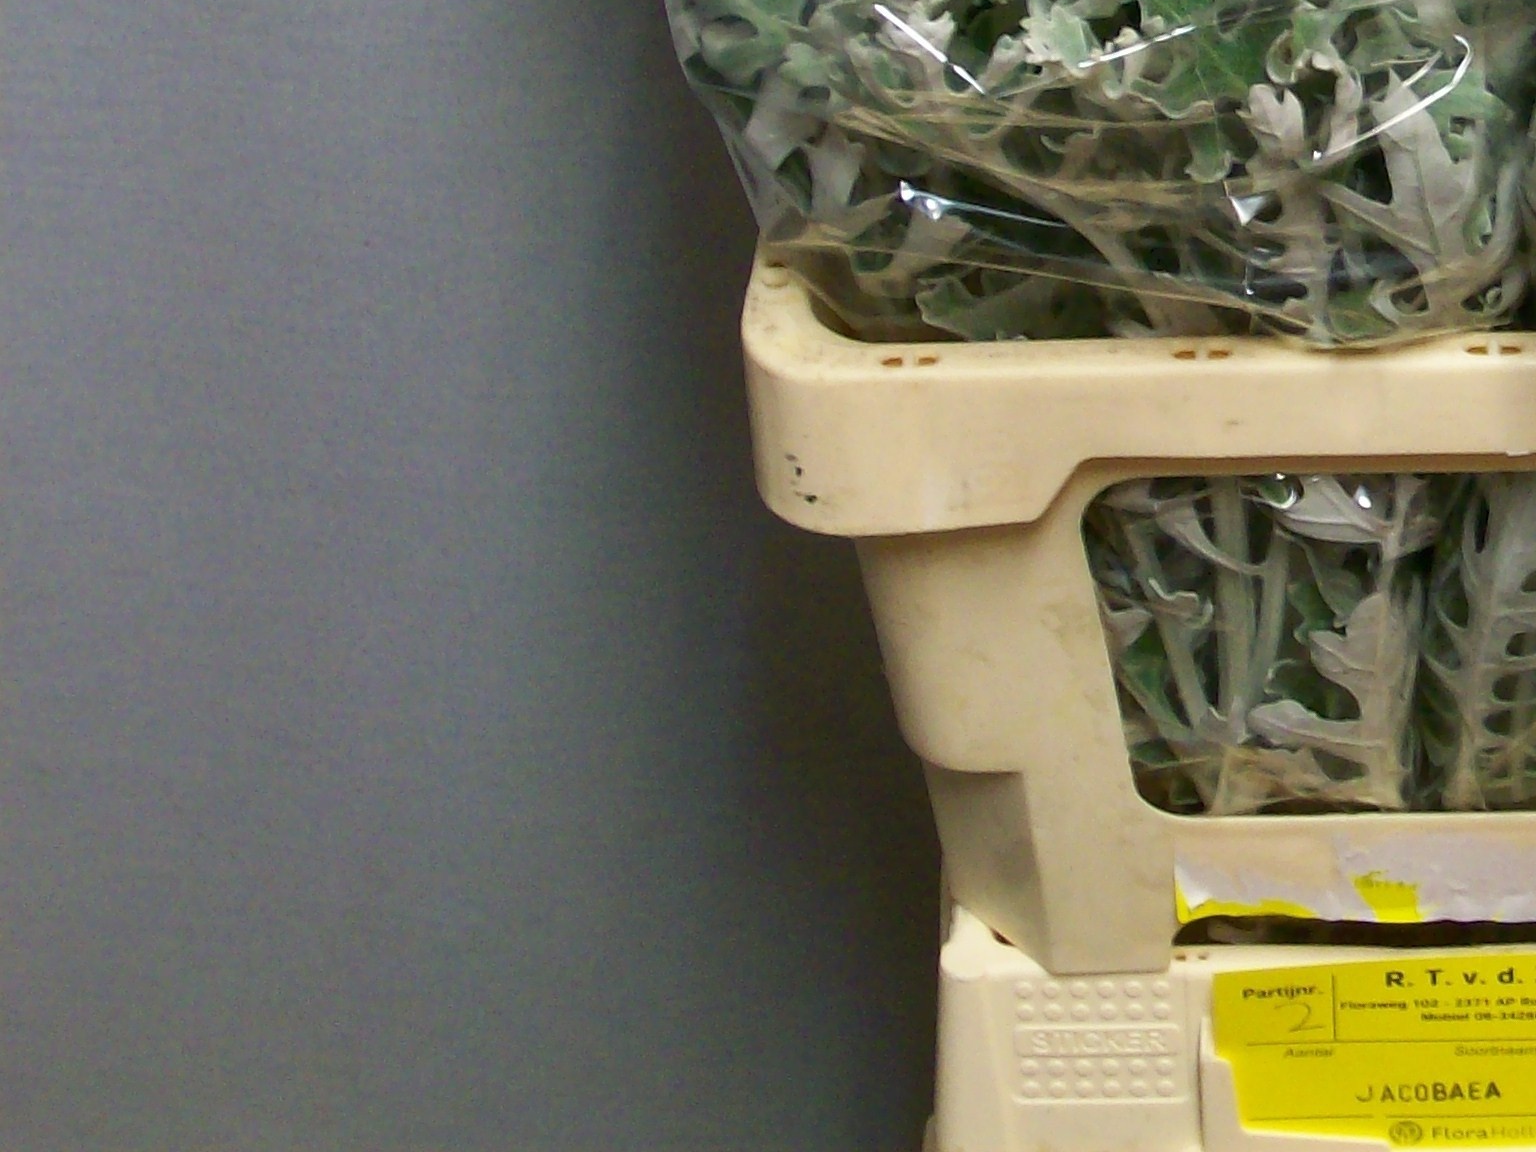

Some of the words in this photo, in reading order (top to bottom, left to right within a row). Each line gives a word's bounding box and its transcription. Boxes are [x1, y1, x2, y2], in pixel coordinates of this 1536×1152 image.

[1385, 970, 1414, 989] R.
[1426, 968, 1452, 986] T.
[1462, 971, 1486, 985] v.
[1497, 967, 1523, 984] d.
[1273, 1001, 1325, 1032] 2
[1031, 1031, 1167, 1053] STICKER
[1355, 1080, 1502, 1104] JACOBAEA
